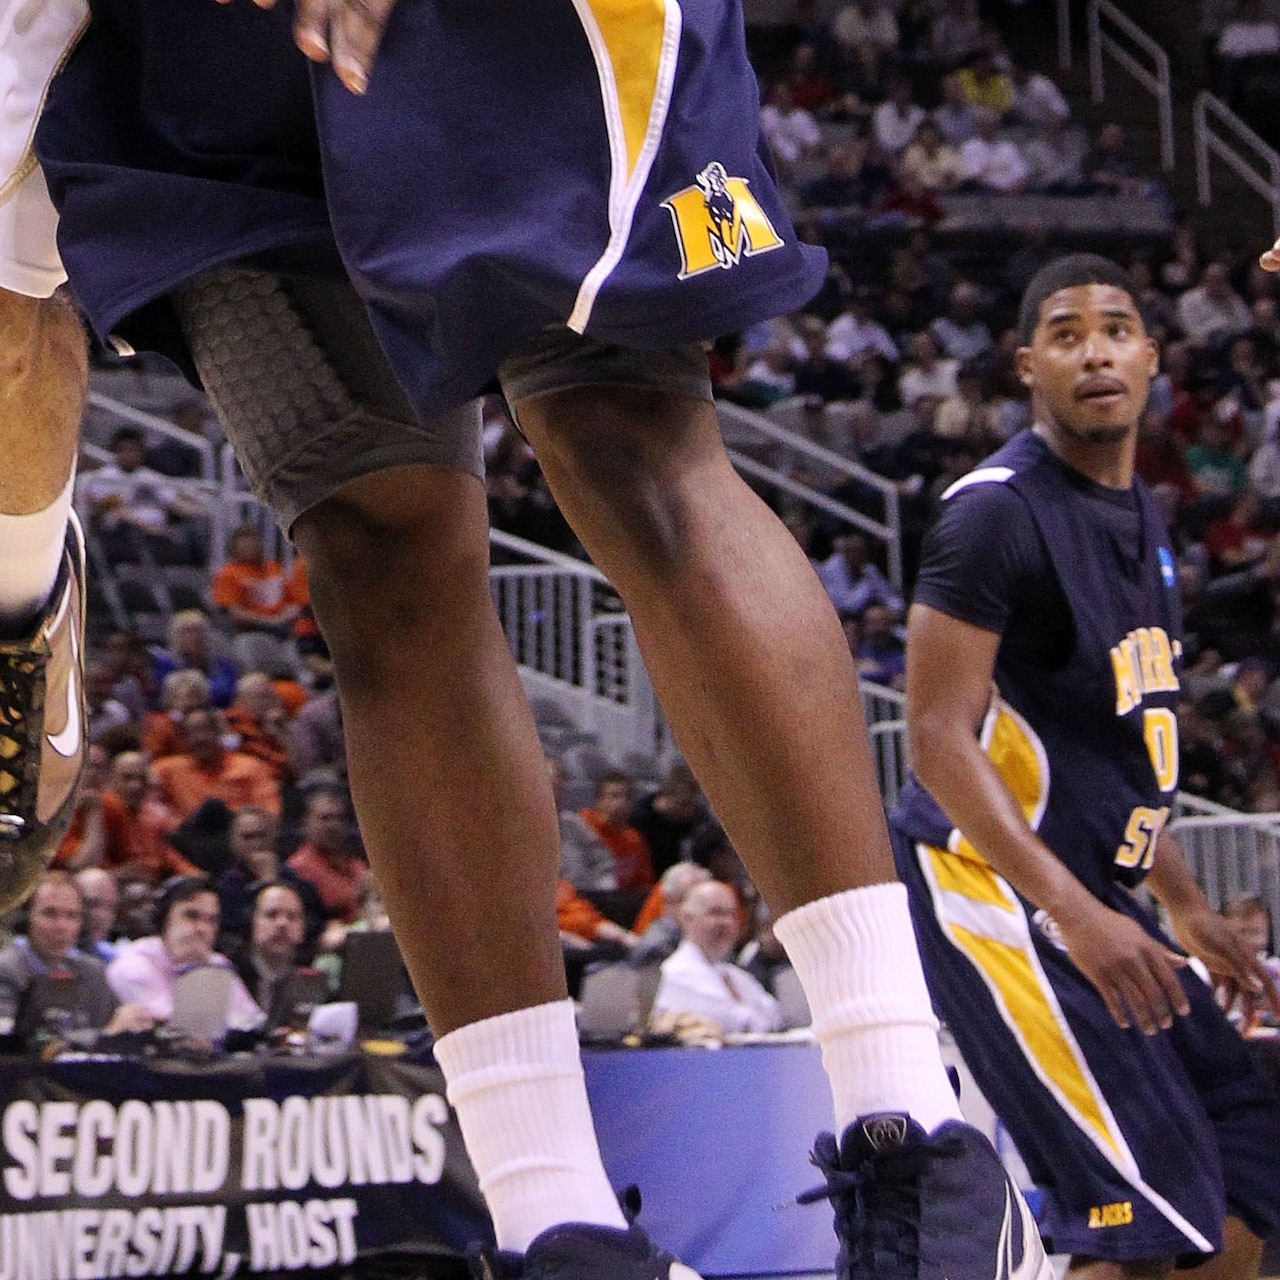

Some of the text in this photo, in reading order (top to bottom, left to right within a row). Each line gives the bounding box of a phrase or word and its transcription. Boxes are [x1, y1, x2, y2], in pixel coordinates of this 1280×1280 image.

[2, 1097, 231, 1201] SECOND
[241, 1093, 449, 1190] ROUNDS
[246, 1197, 358, 1272] HOST
